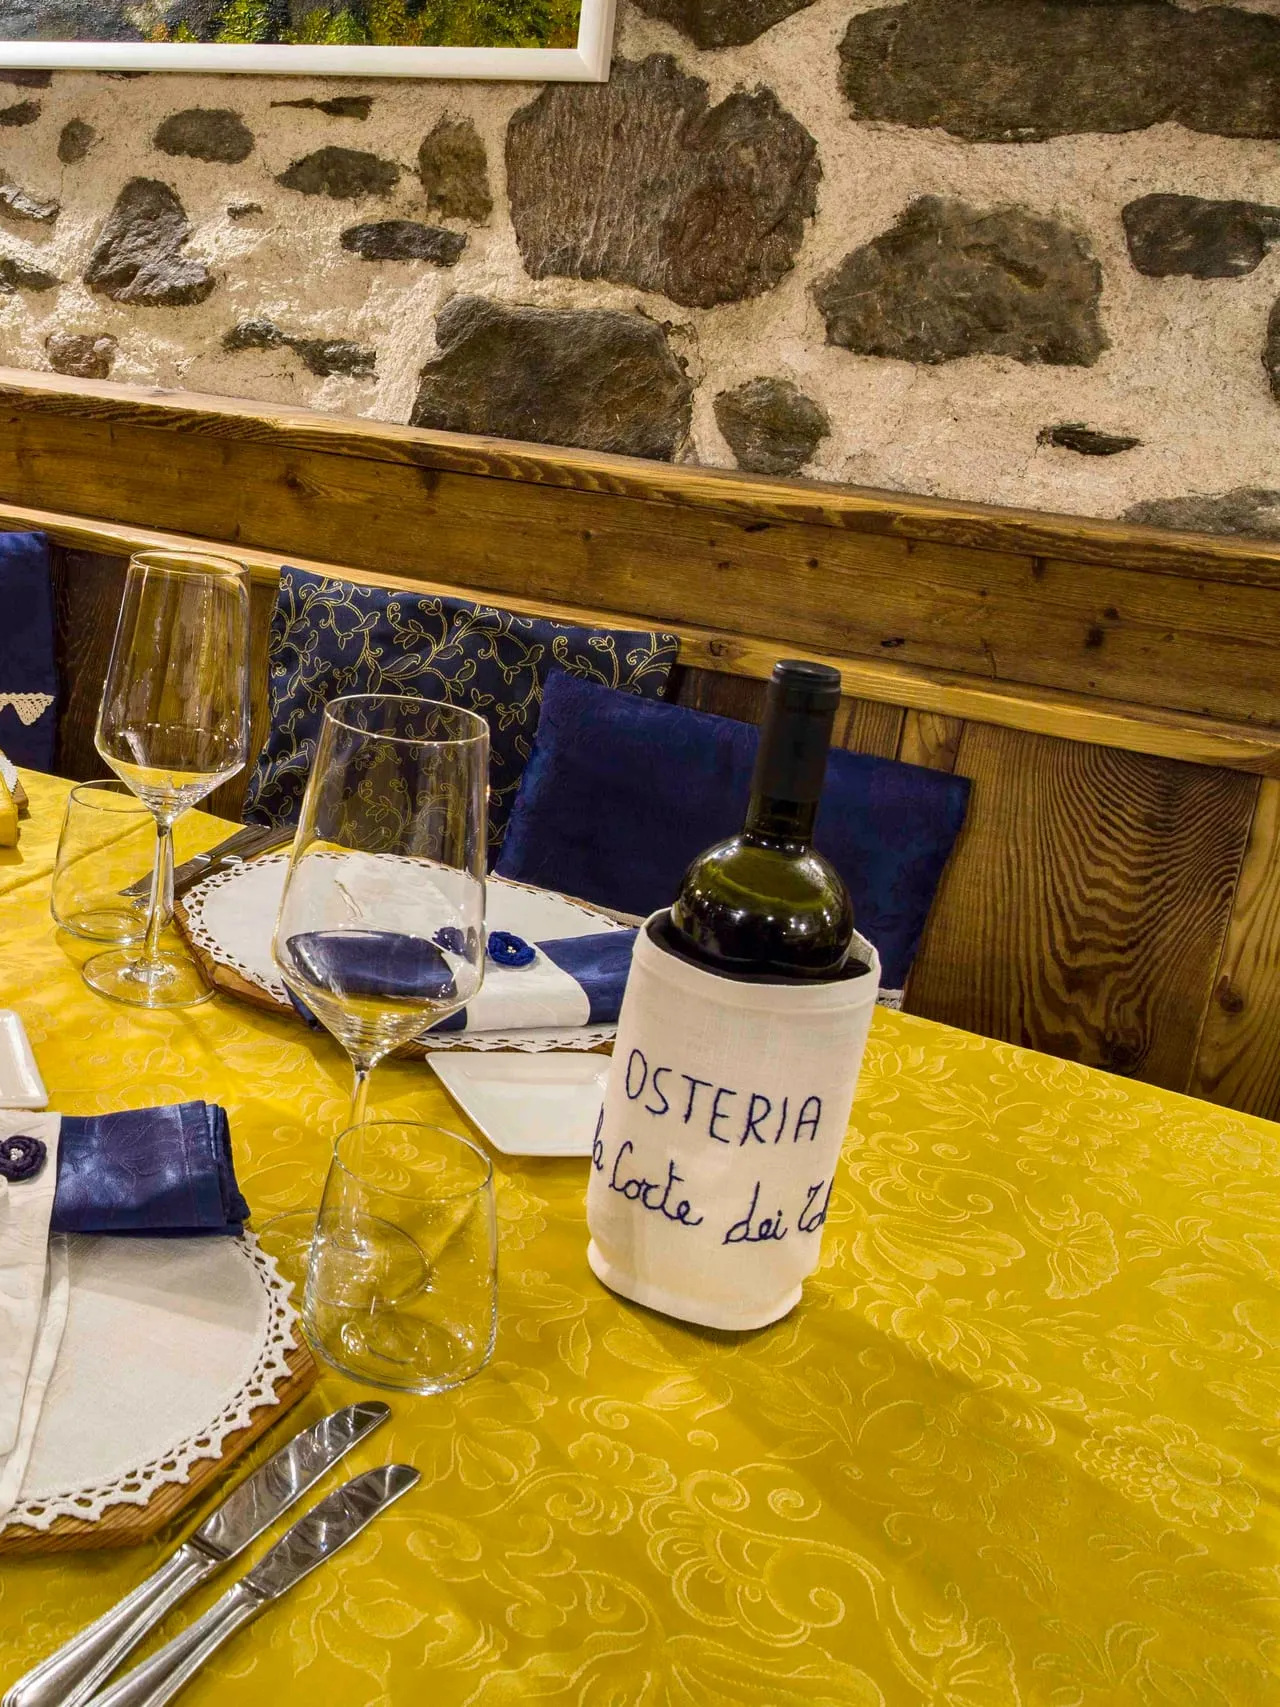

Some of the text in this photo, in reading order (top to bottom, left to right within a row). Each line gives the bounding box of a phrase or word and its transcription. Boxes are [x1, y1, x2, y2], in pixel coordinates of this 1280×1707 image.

[625, 1048, 822, 1146] OSTERIA
[608, 1140, 704, 1226] Corte
[721, 1180, 788, 1245] dei
